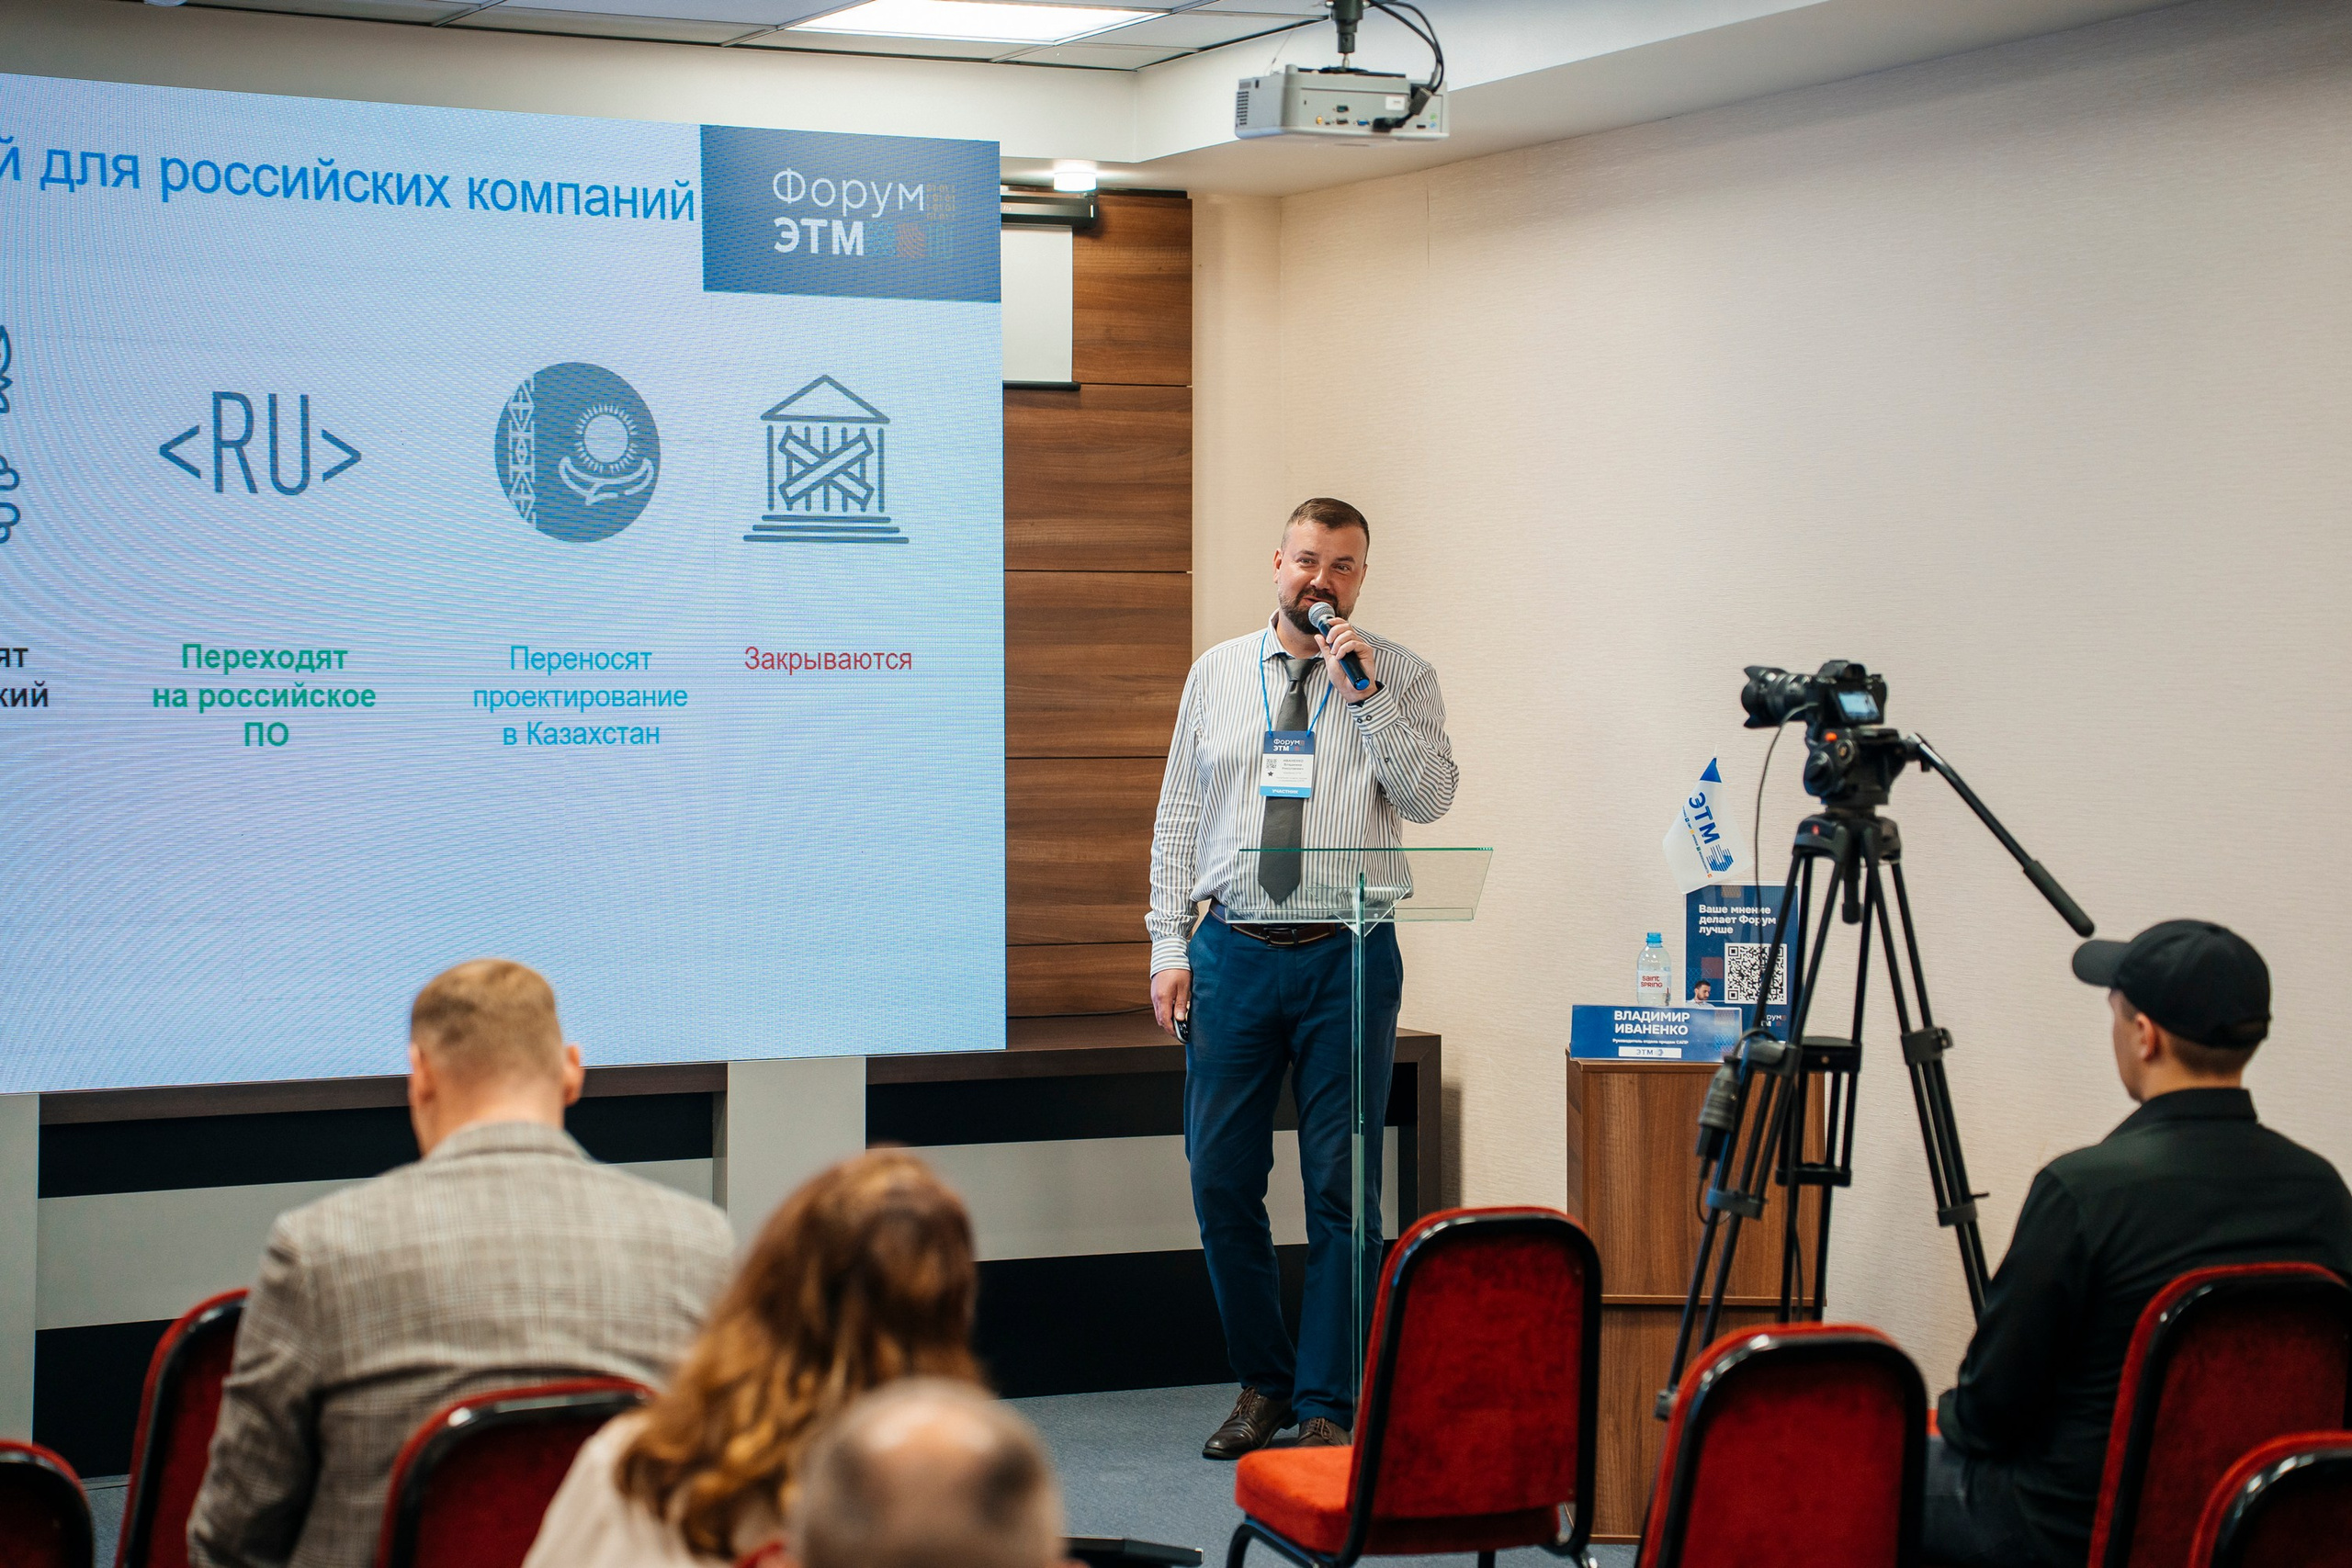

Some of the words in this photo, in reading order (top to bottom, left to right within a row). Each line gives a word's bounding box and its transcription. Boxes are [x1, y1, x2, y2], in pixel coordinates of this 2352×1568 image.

[40, 148, 140, 192] для
[160, 156, 450, 209] российских
[468, 175, 696, 221] компаний
[773, 167, 924, 218] Форум
[774, 217, 865, 256] ЭТМ
[182, 643, 348, 675] Переходят
[510, 646, 652, 676] Переносят
[744, 646, 913, 675] Закрываются
[153, 688, 188, 707] на
[198, 682, 377, 713] российское
[473, 687, 688, 712] проектирование
[243, 722, 289, 747] ПО
[503, 728, 518, 746] в
[526, 720, 660, 746] Казахстан
[1689, 792, 1720, 844] ЭТМ
[1699, 904, 1728, 914] Ваше
[1699, 916, 1736, 925] делает
[1738, 915, 1777, 927] Форум
[1699, 926, 1734, 936] лучше
[1614, 1010, 1690, 1023] ВЛАДИМИР
[1614, 1023, 1689, 1035] ИВАНЕНКО
